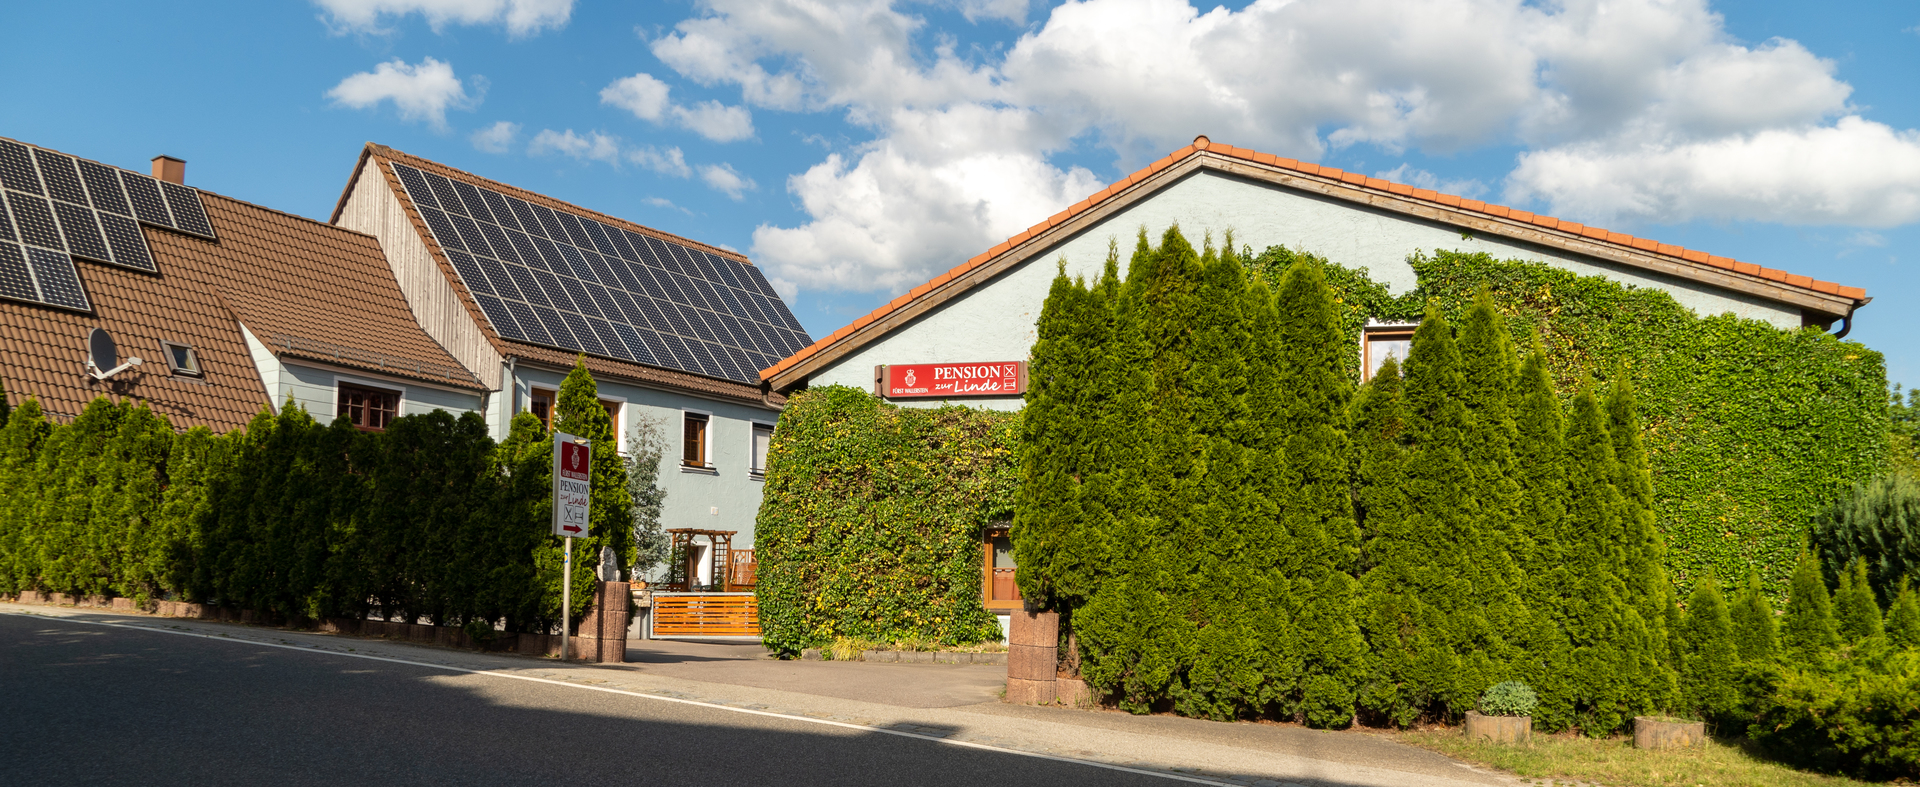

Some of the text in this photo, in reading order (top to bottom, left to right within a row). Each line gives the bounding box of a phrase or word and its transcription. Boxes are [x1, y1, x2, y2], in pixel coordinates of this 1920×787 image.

[934, 366, 1001, 380] PENSION
[954, 379, 1002, 392] Linde
[560, 480, 589, 495] PENSION
[568, 493, 588, 506] Linde
